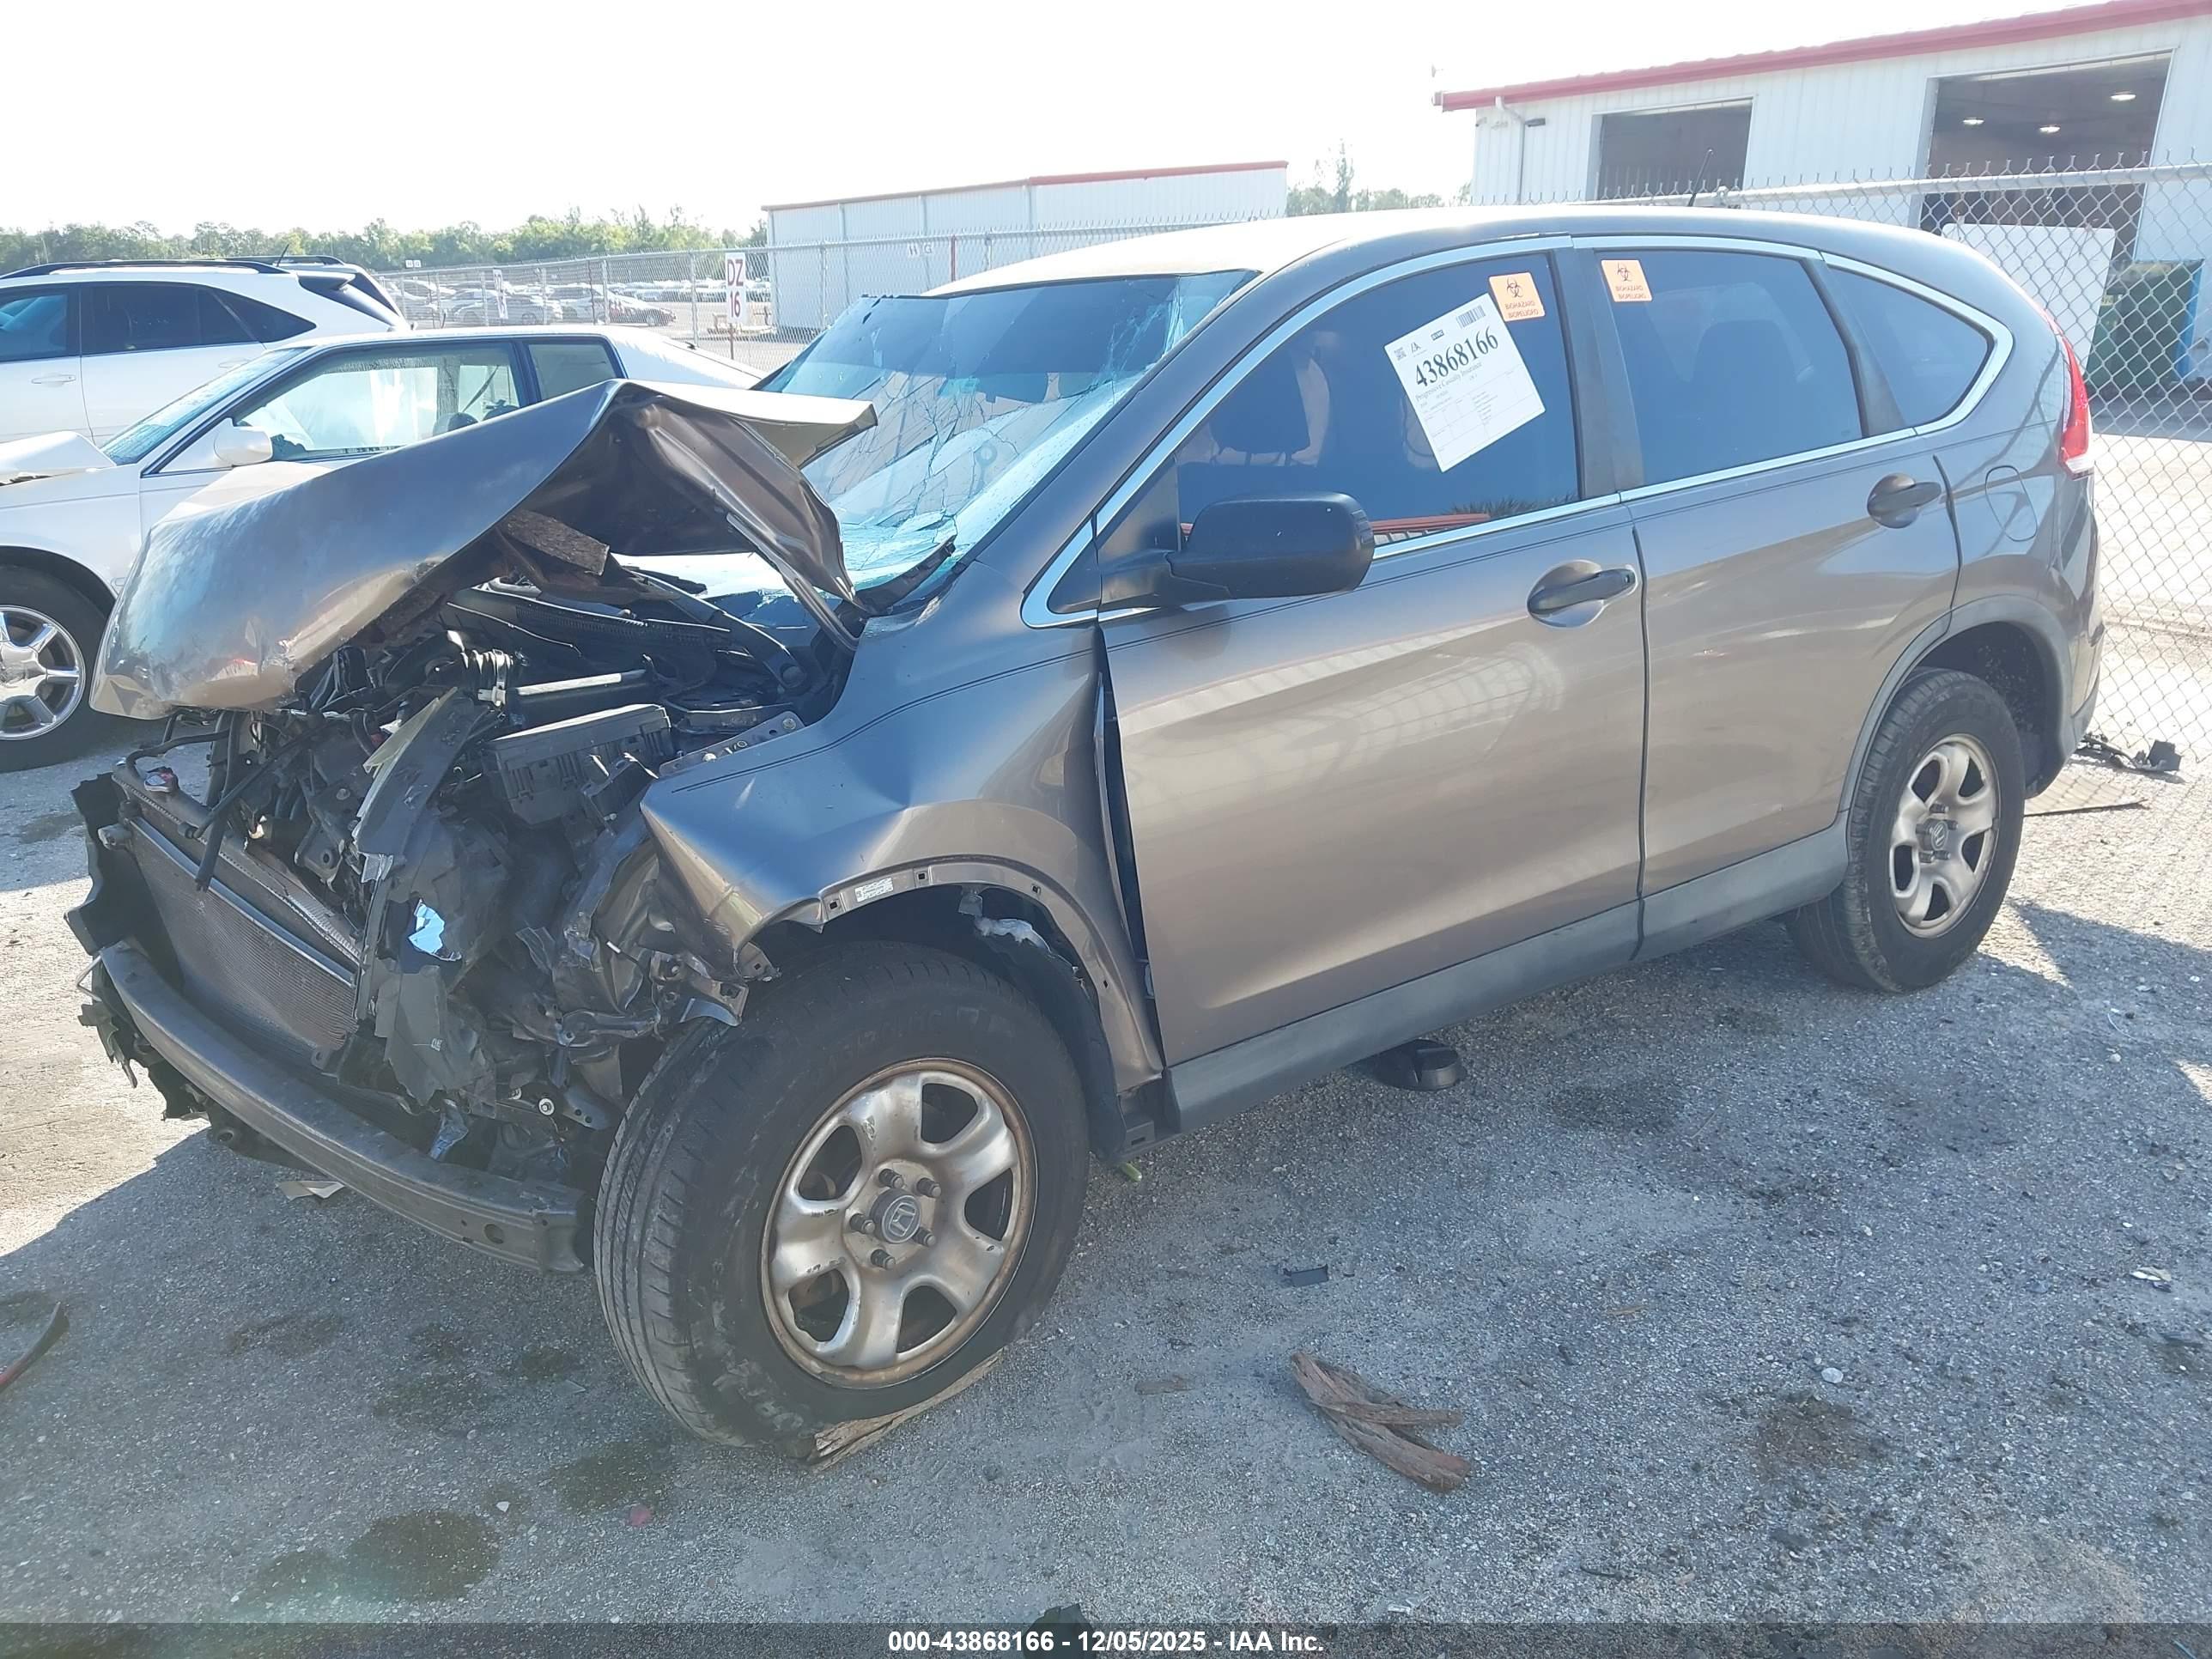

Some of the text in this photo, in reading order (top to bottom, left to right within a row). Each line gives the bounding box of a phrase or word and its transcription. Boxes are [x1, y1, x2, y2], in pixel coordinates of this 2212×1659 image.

[727, 259, 744, 286] DZ
[730, 291, 741, 318] 16
[1416, 325, 1498, 387] 43868166
